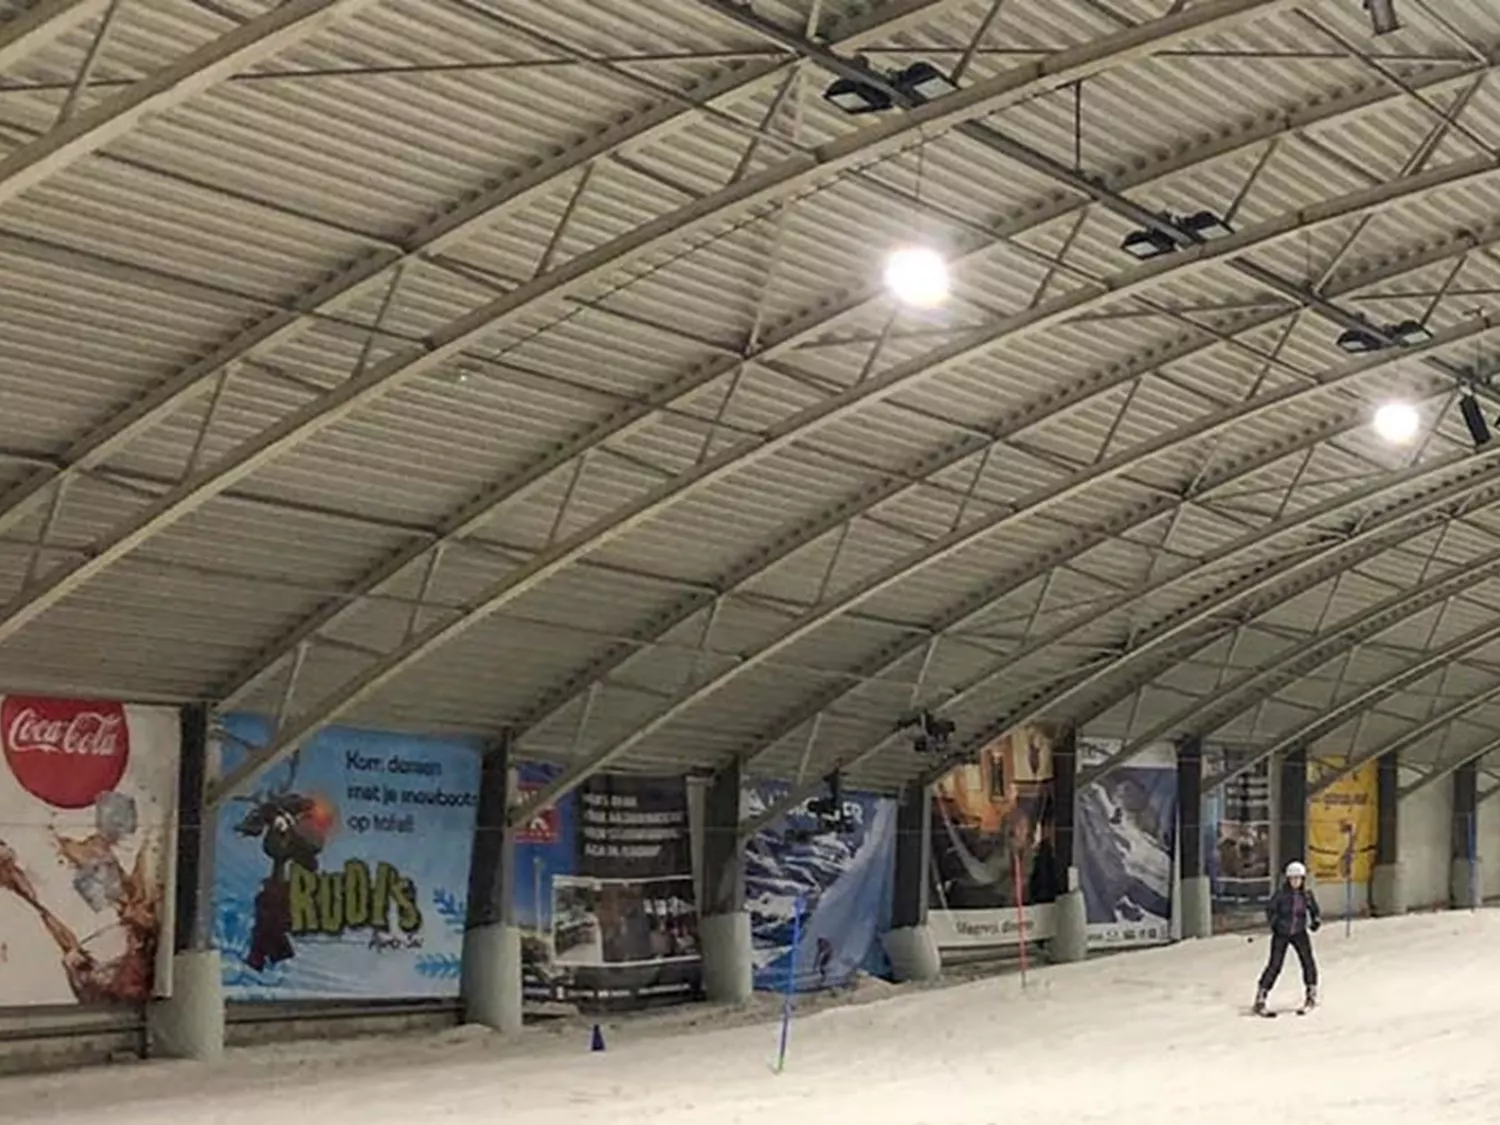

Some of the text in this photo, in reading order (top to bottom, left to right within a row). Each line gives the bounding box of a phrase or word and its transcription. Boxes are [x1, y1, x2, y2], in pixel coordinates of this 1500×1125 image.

[8, 707, 122, 756] Coca-Cola
[346, 749, 383, 771] Kom
[346, 815, 371, 834] op
